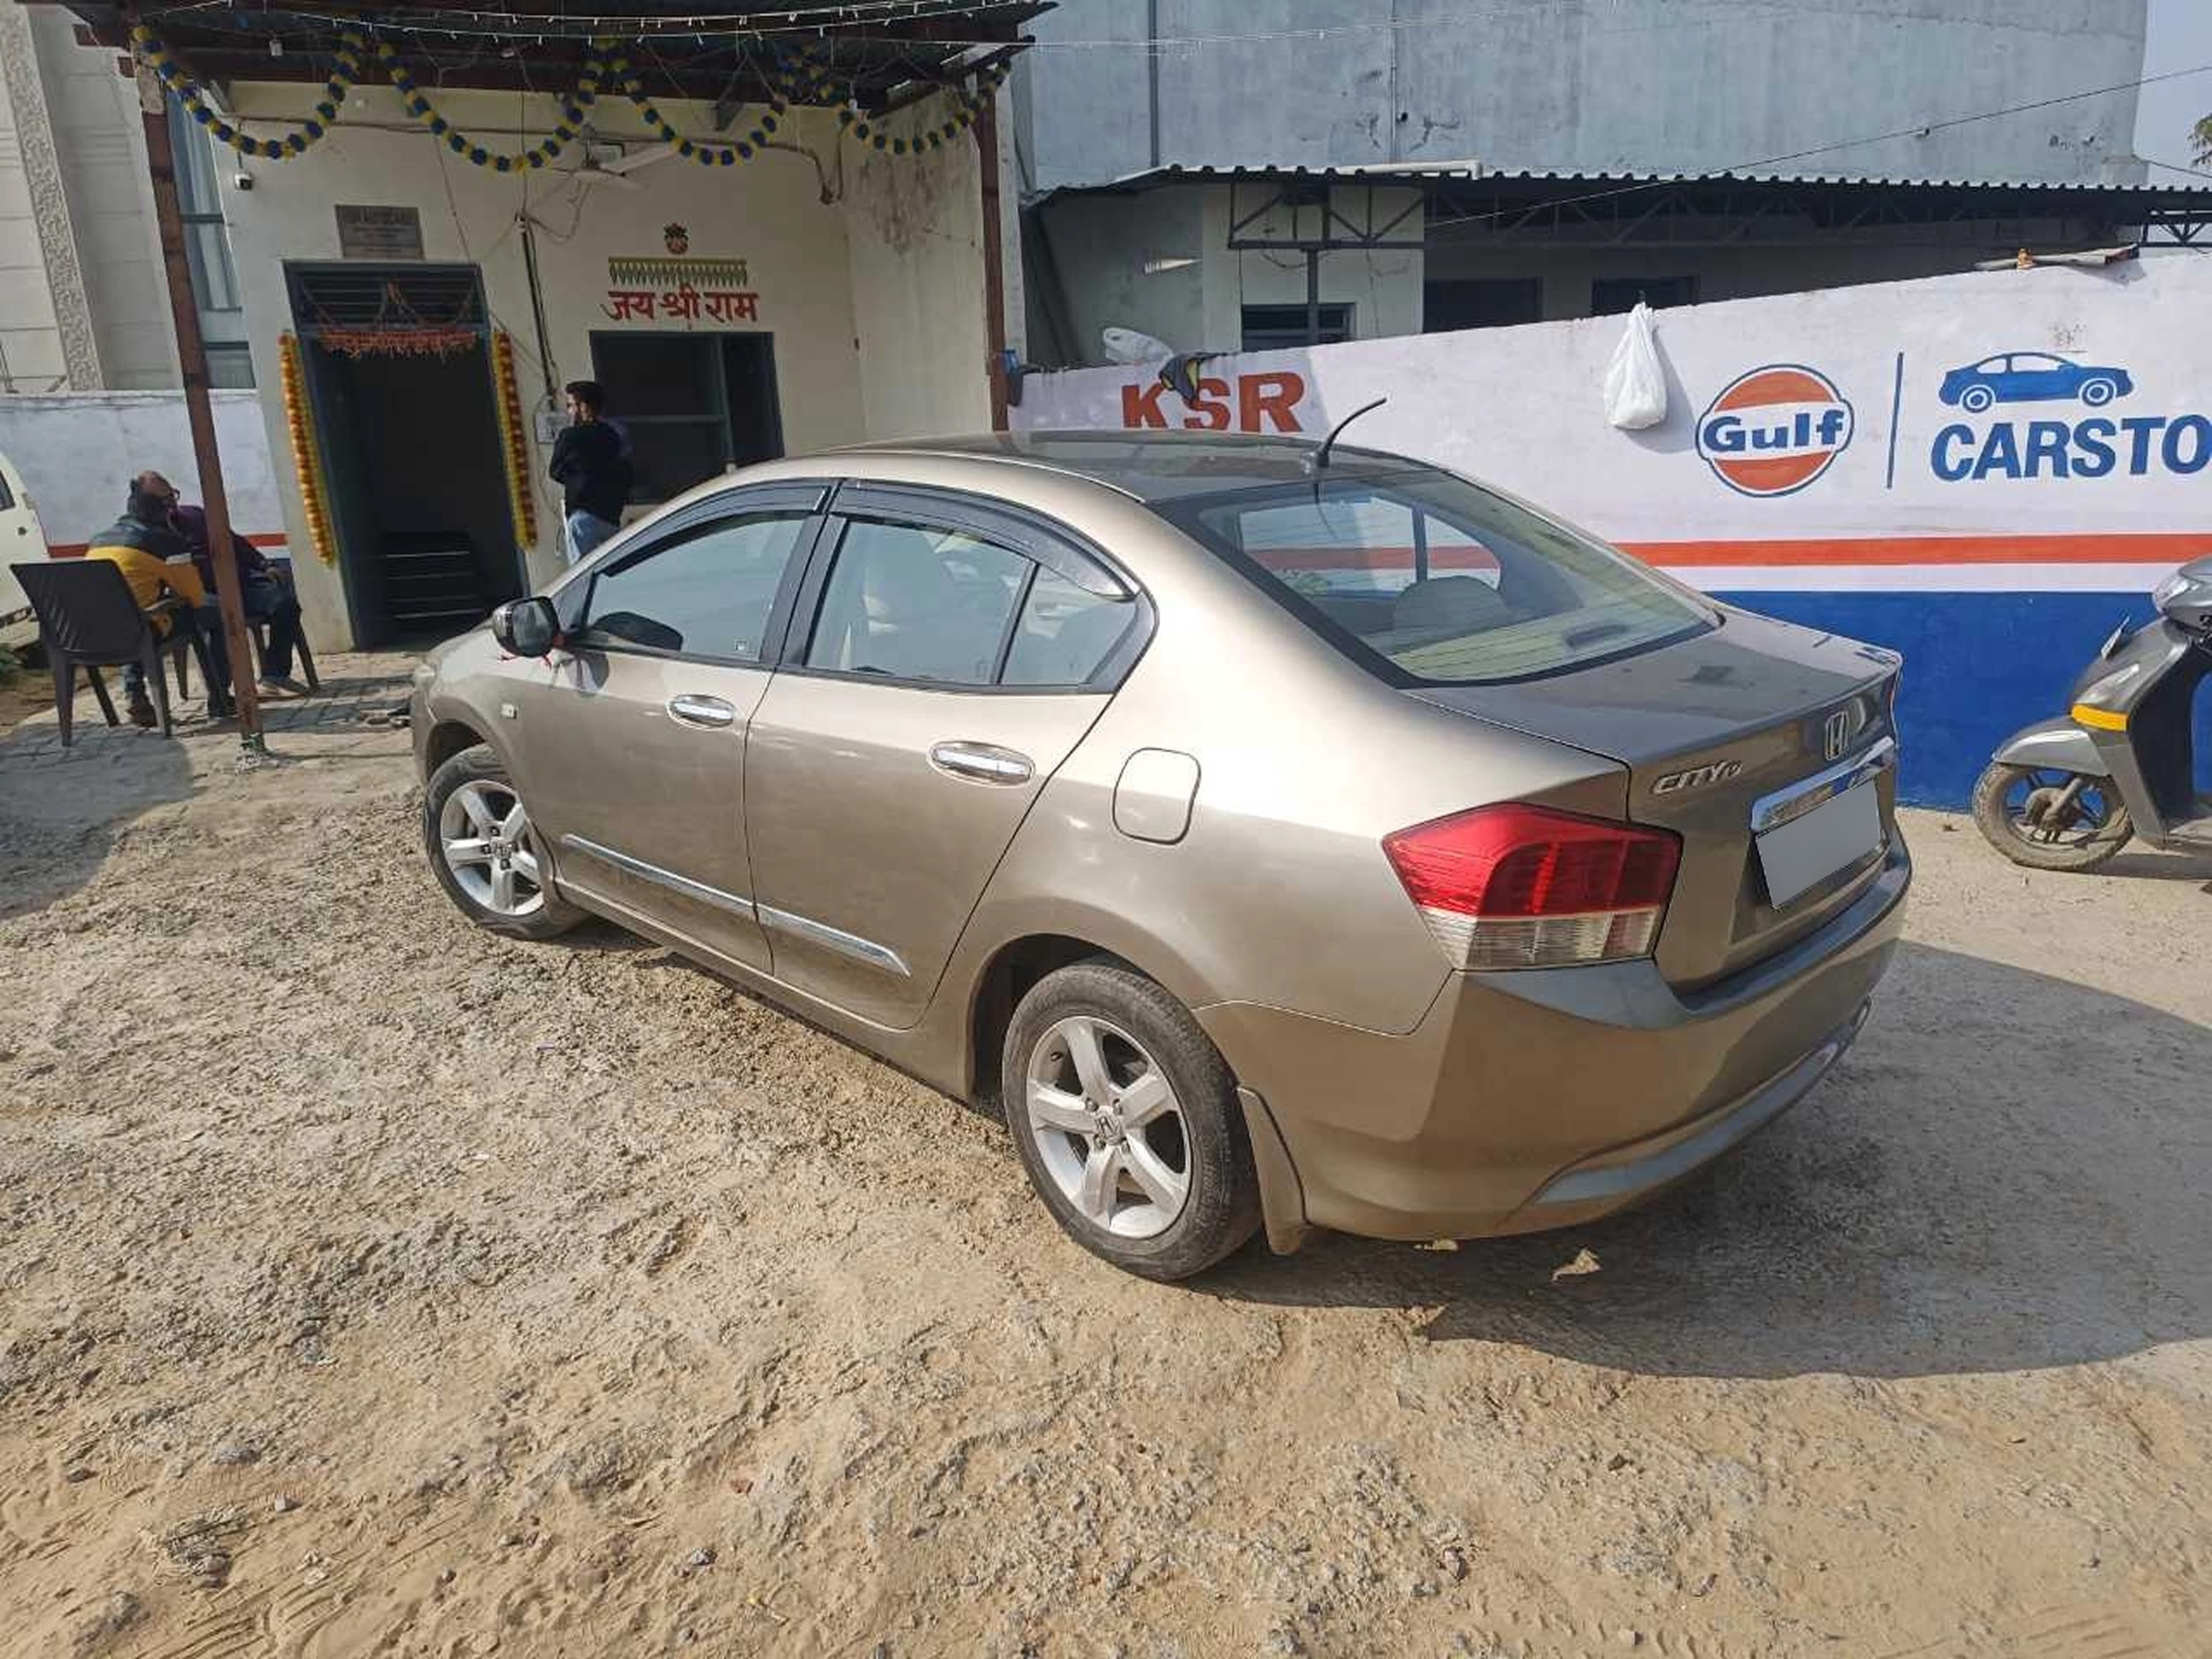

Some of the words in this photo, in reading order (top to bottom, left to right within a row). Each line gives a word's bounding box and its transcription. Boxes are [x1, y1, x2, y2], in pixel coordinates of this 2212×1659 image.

[600, 291, 656, 320] जय
[660, 282, 700, 319] श्री
[703, 292, 759, 323] राम
[1122, 372, 1304, 433] KSR
[1703, 410, 1844, 452] Gulf
[1931, 414, 2212, 482] CARSTO
